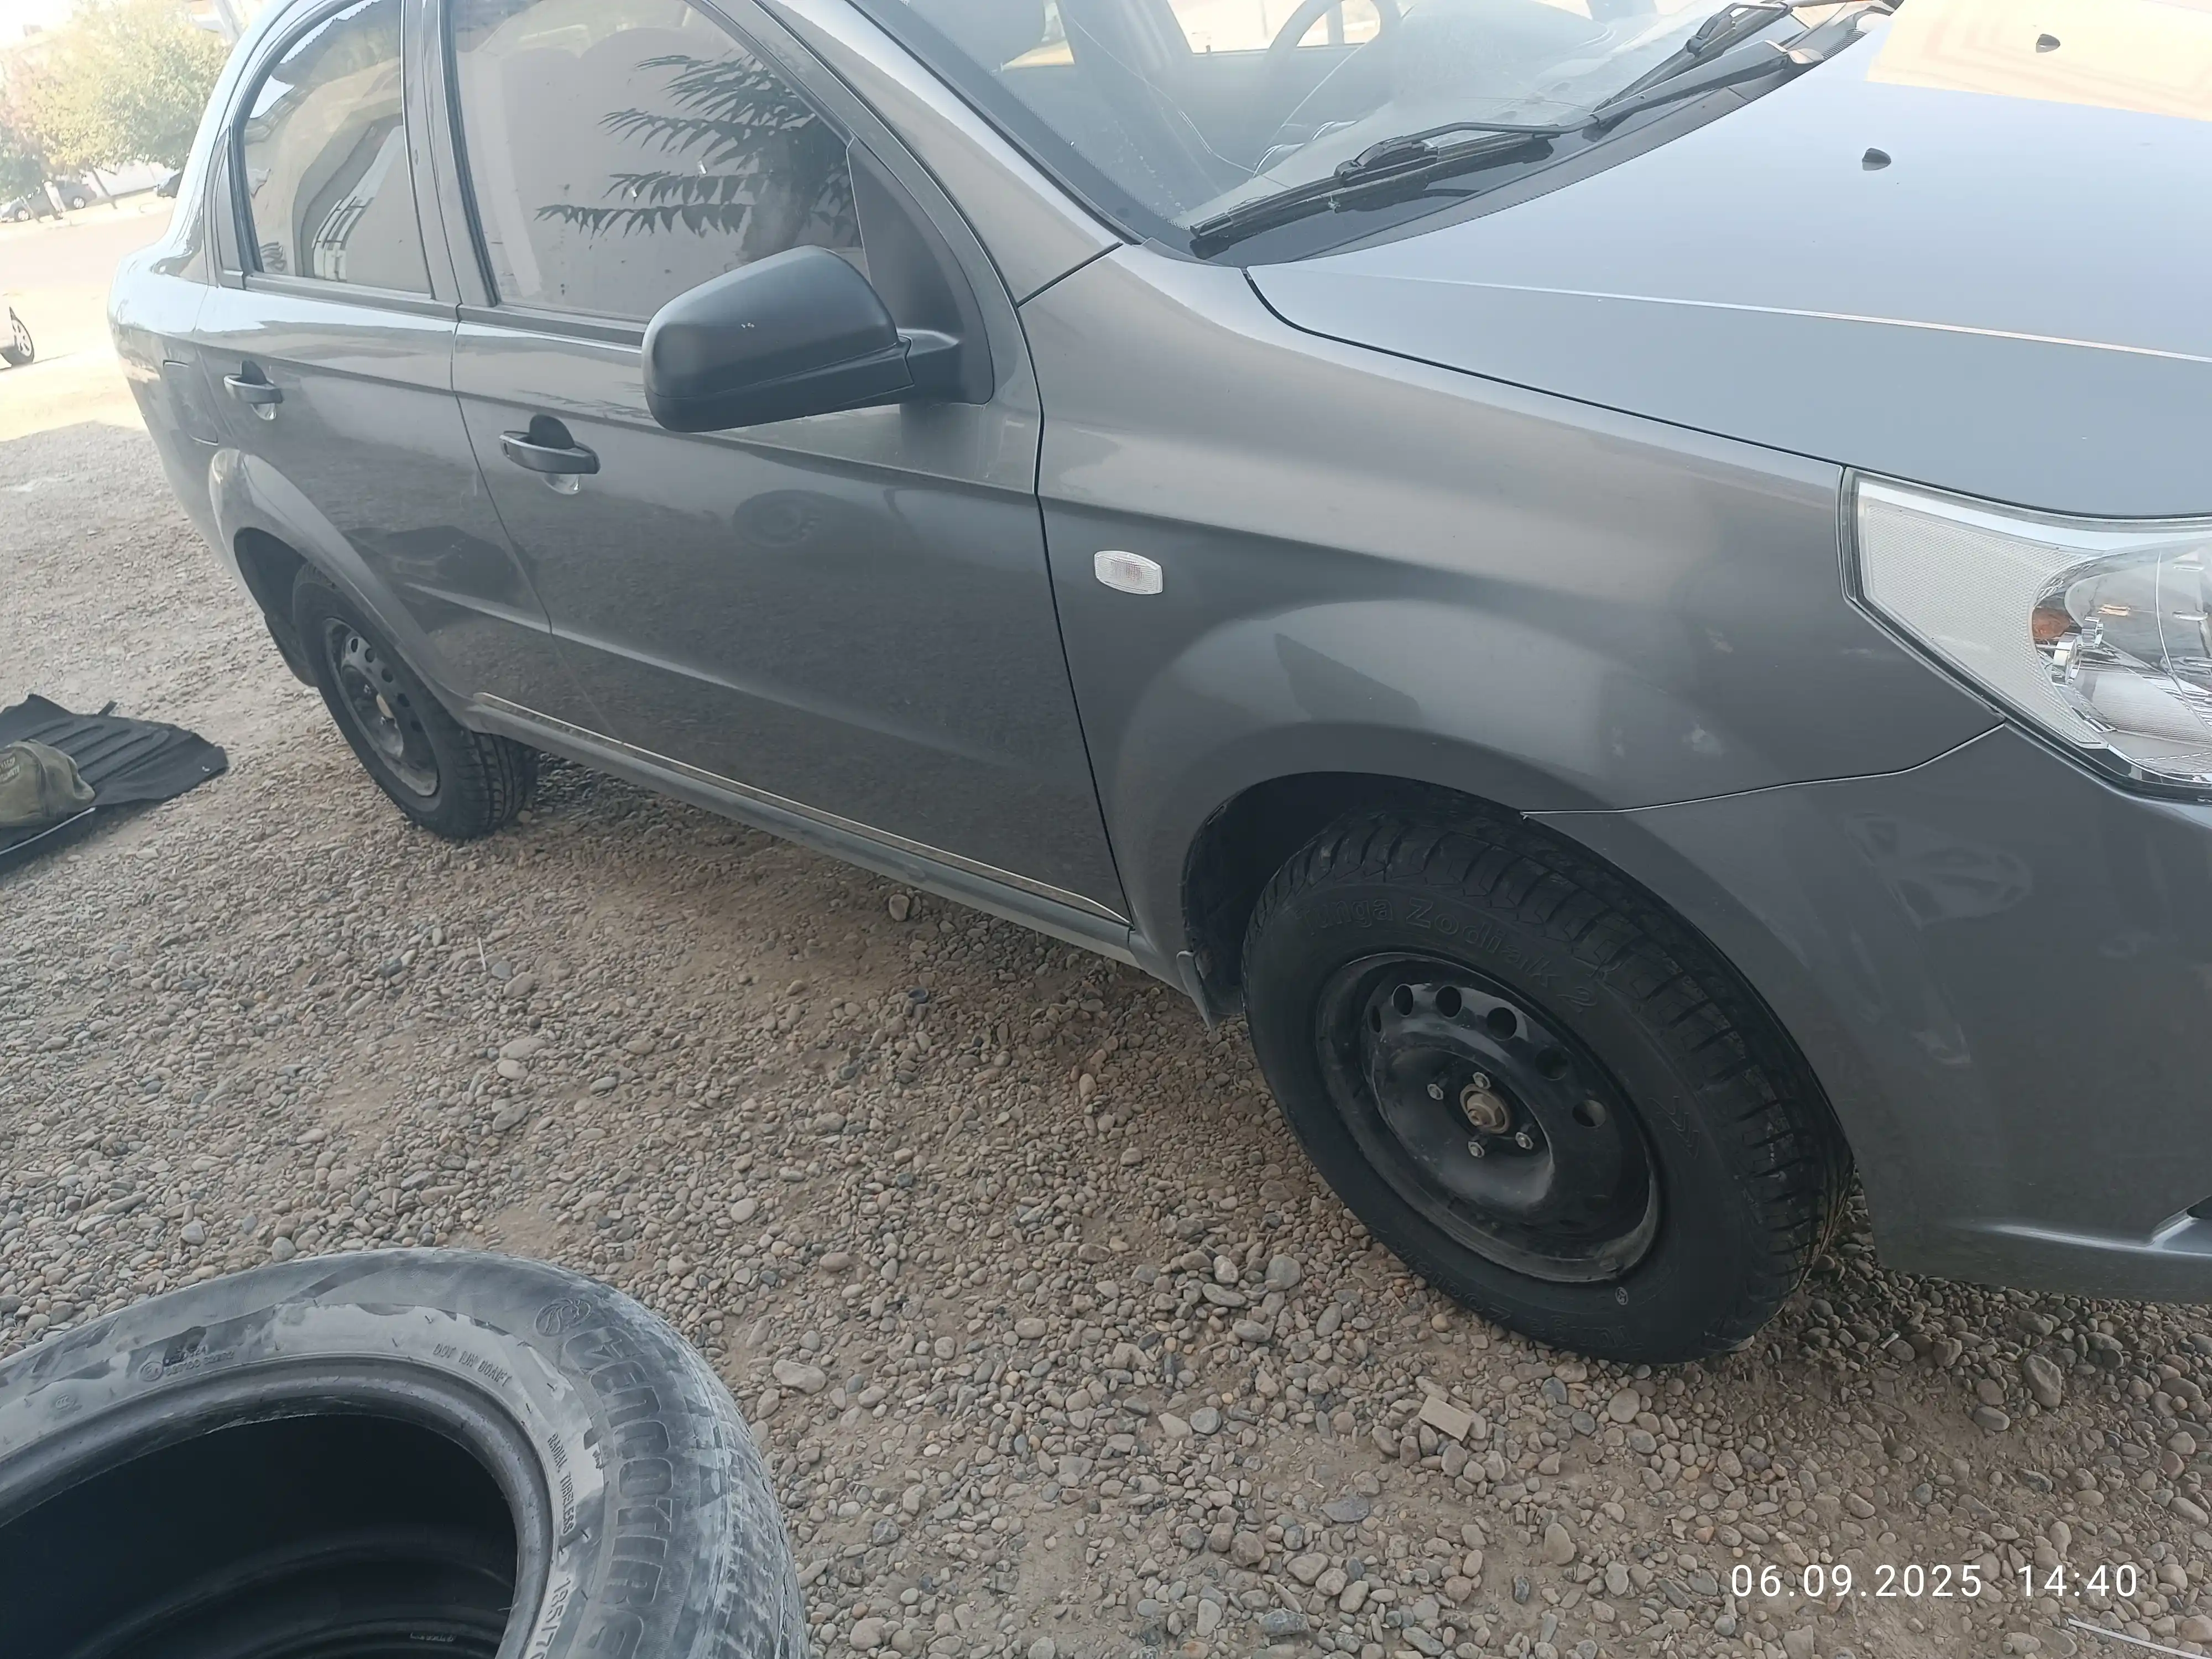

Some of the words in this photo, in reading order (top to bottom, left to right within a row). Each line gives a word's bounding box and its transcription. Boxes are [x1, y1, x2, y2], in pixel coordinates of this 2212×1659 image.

[1295, 897, 1394, 936] Tunga
[1405, 897, 1561, 988] Zodiak
[432, 1343, 457, 1358] DOT
[547, 1432, 568, 1473] RADIAL
[560, 1470, 575, 1535] TUBELESS
